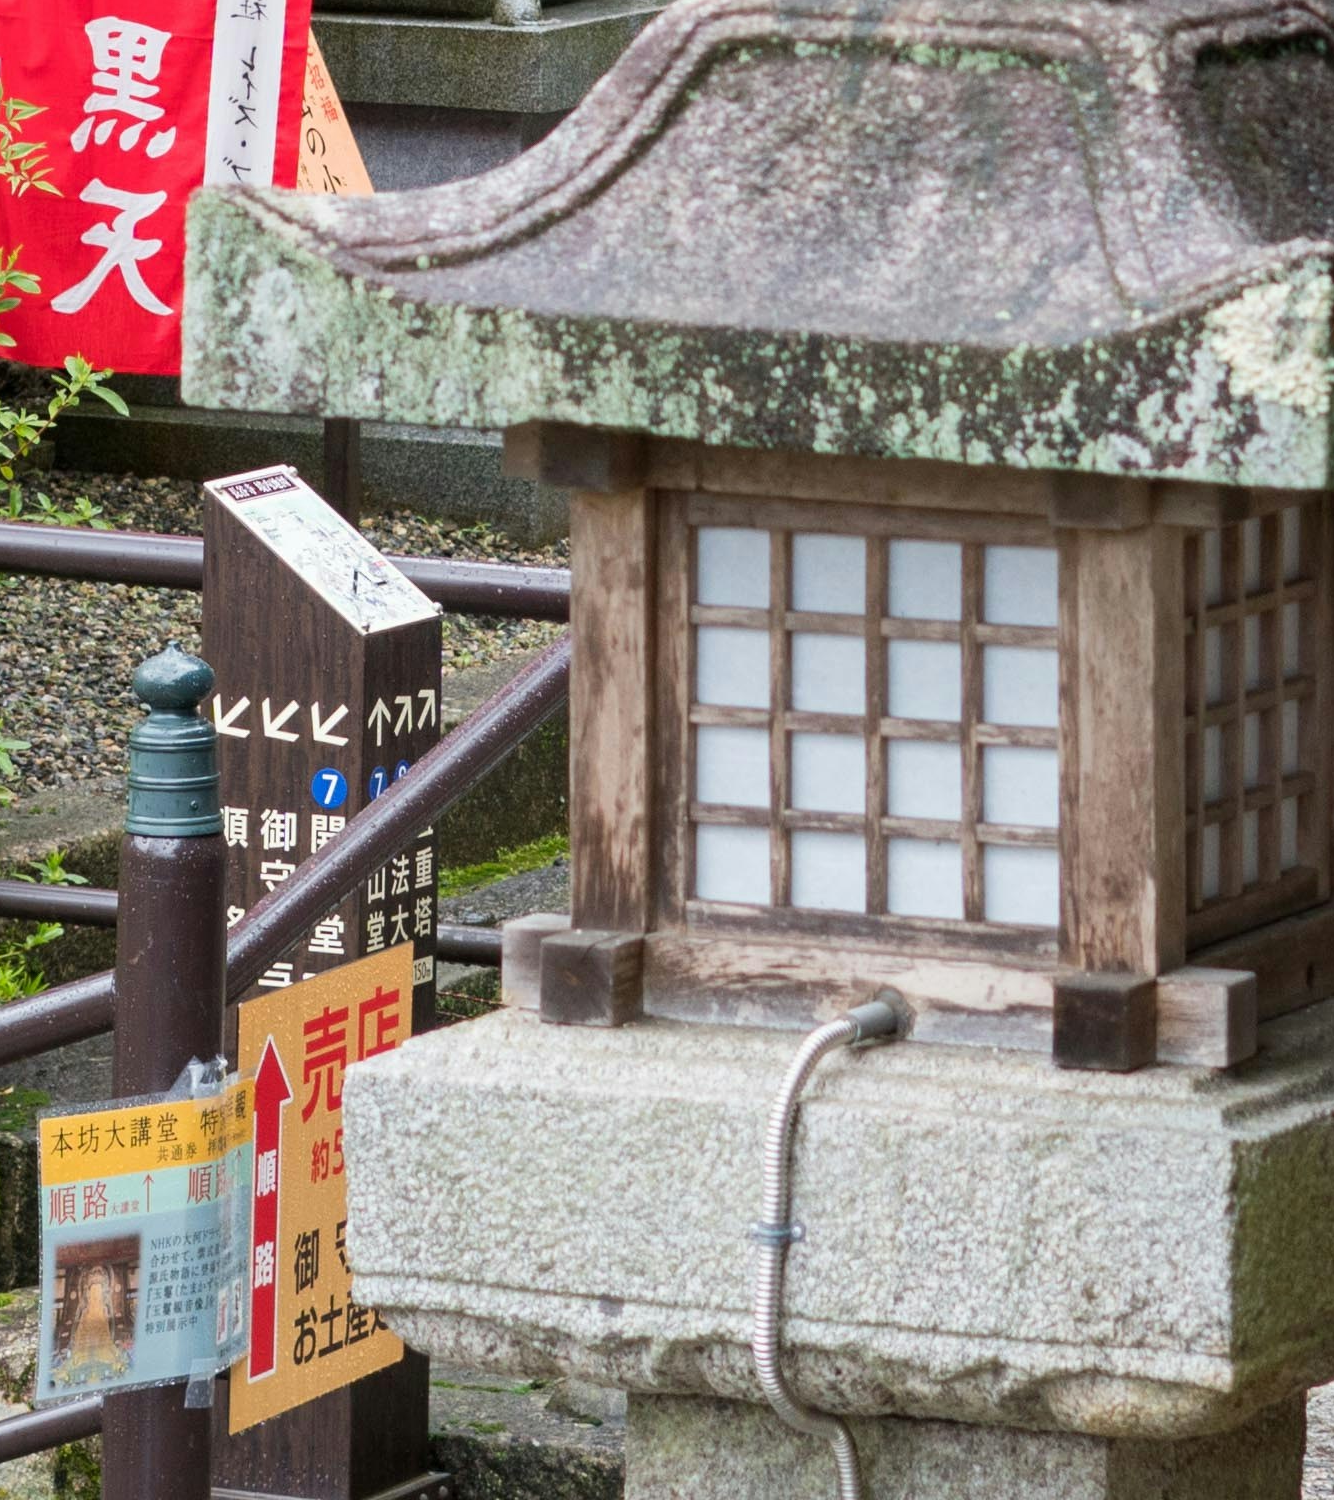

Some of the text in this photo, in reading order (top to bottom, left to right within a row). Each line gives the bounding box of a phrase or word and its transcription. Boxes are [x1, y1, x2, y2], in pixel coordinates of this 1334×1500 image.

[321, 773, 338, 805] 7
[301, 985, 402, 1124] 売店
[50, 1111, 179, 1159] 本坊大講堂
[48, 1181, 109, 1225] 順路
[252, 1149, 278, 1289] 順路
